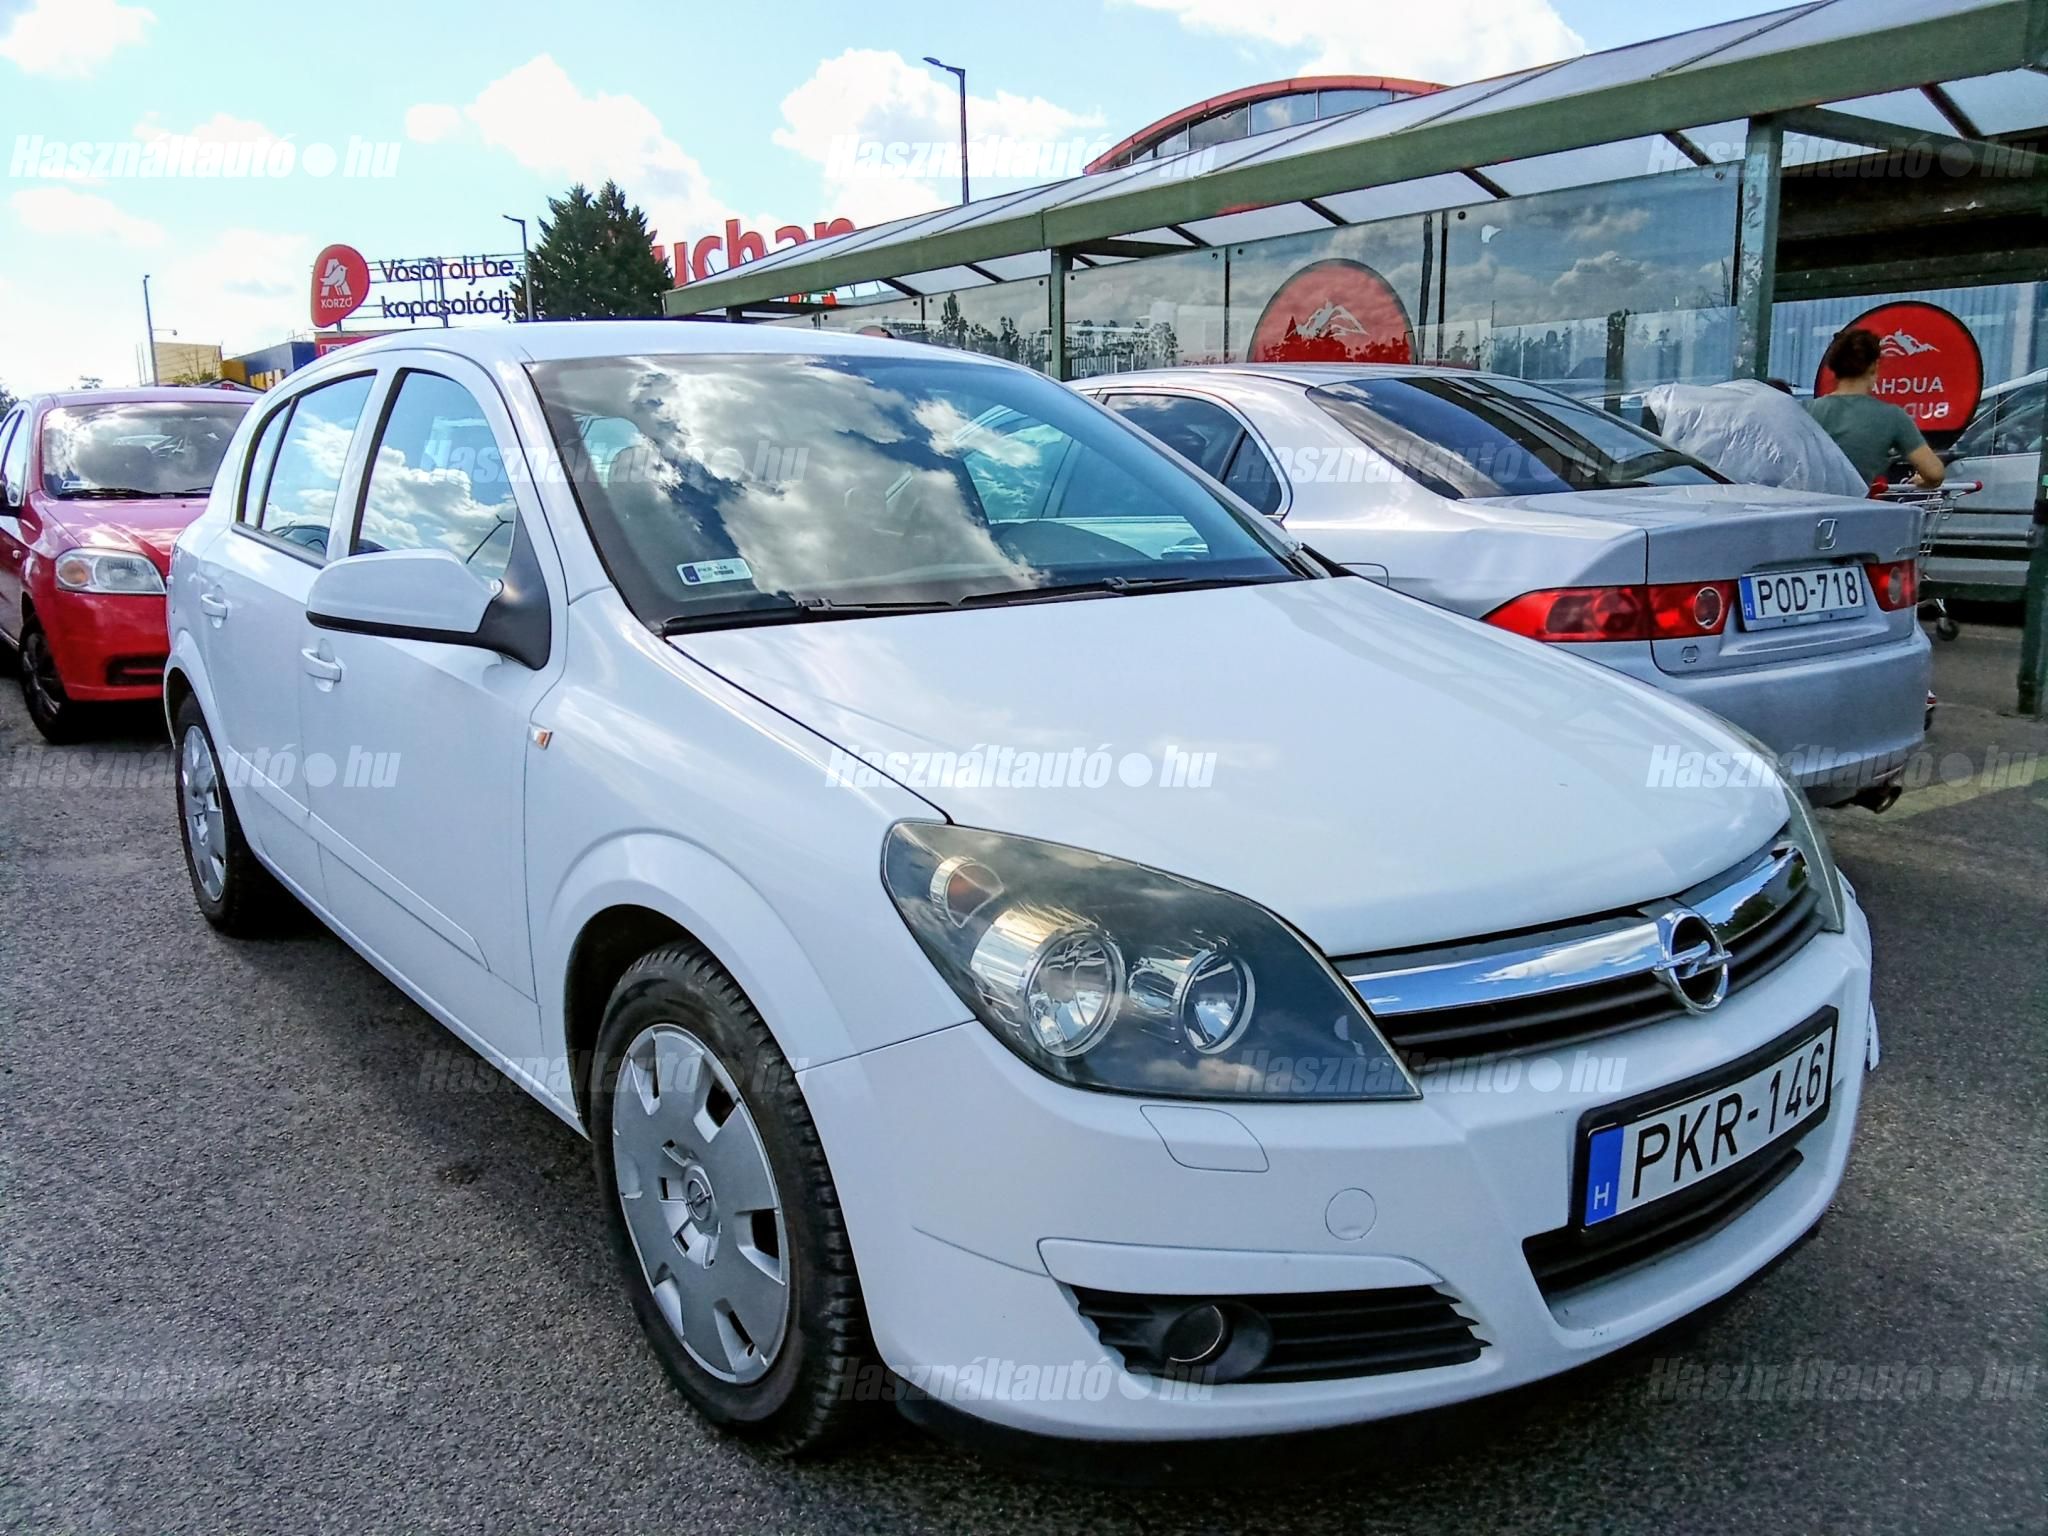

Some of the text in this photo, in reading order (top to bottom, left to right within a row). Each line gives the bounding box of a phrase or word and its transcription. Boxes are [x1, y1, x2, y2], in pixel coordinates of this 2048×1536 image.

[1757, 571, 1858, 616] POD-718
[1593, 1042, 1825, 1210] H PKR-146
